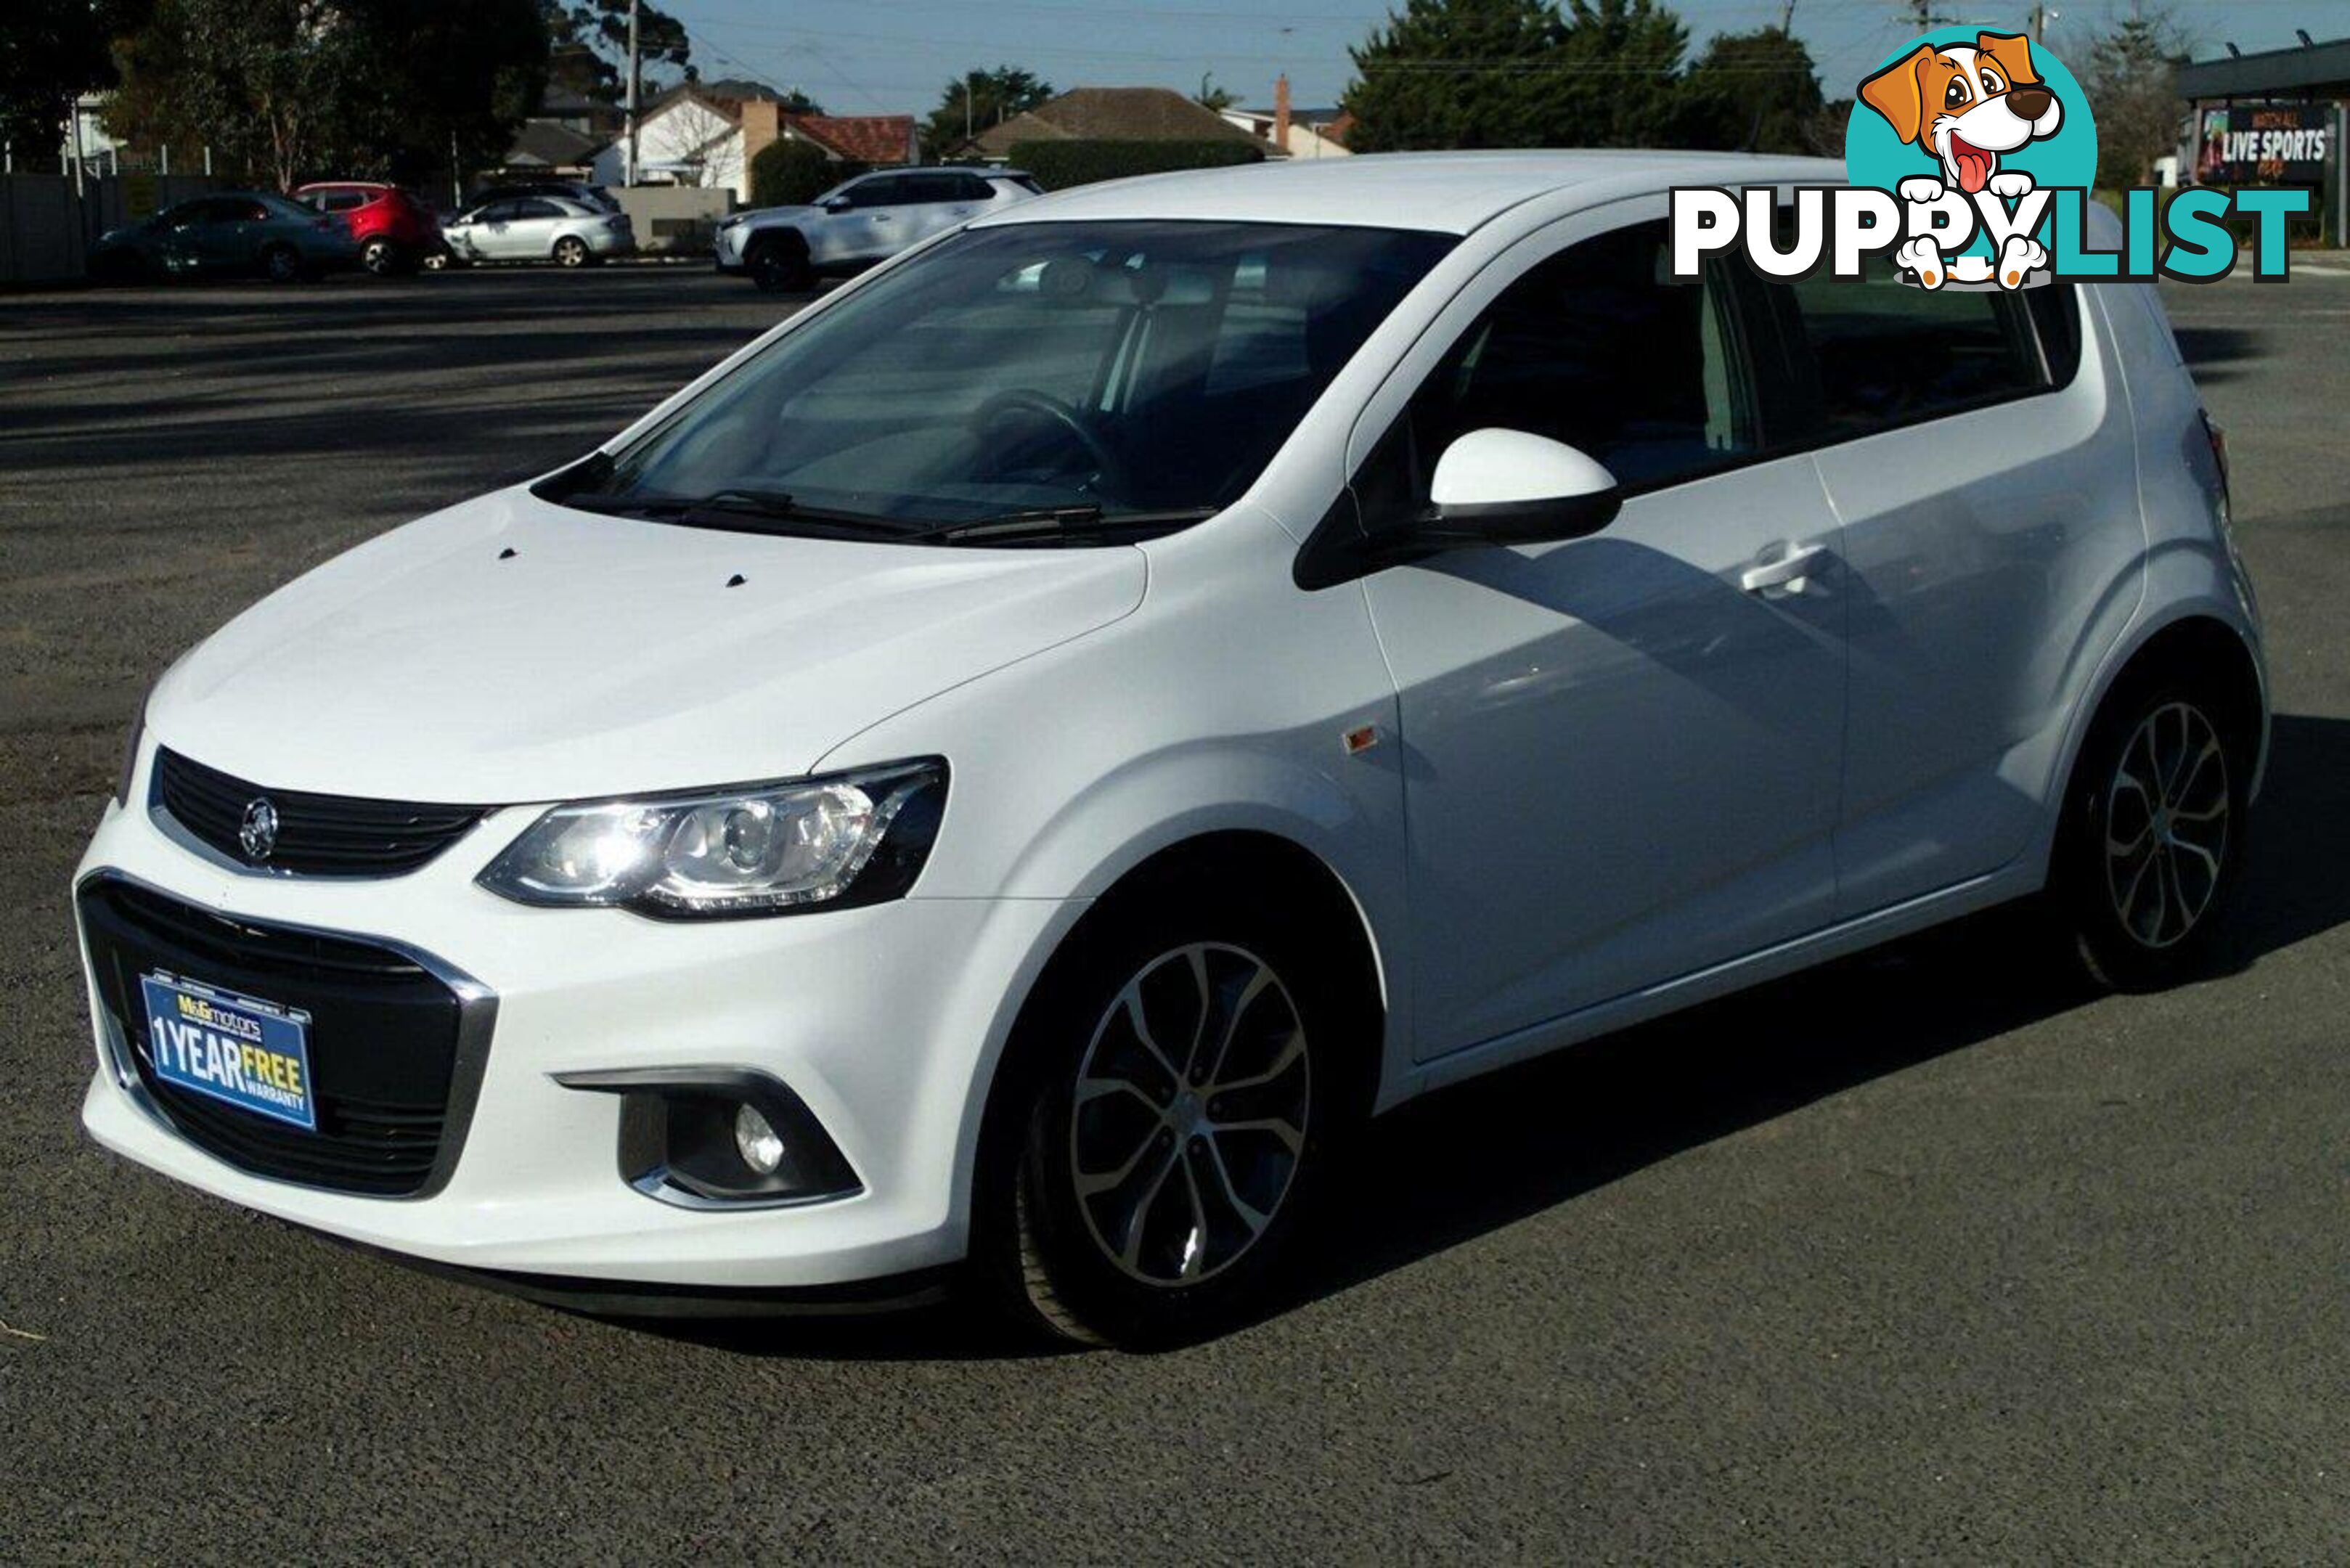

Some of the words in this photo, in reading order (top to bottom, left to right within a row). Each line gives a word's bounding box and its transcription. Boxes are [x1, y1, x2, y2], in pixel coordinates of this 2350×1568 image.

[2222, 131, 2259, 162] LIVE
[2260, 129, 2325, 161] SPORTS
[153, 1016, 169, 1066] 1
[245, 1079, 304, 1111] WARRANTY
